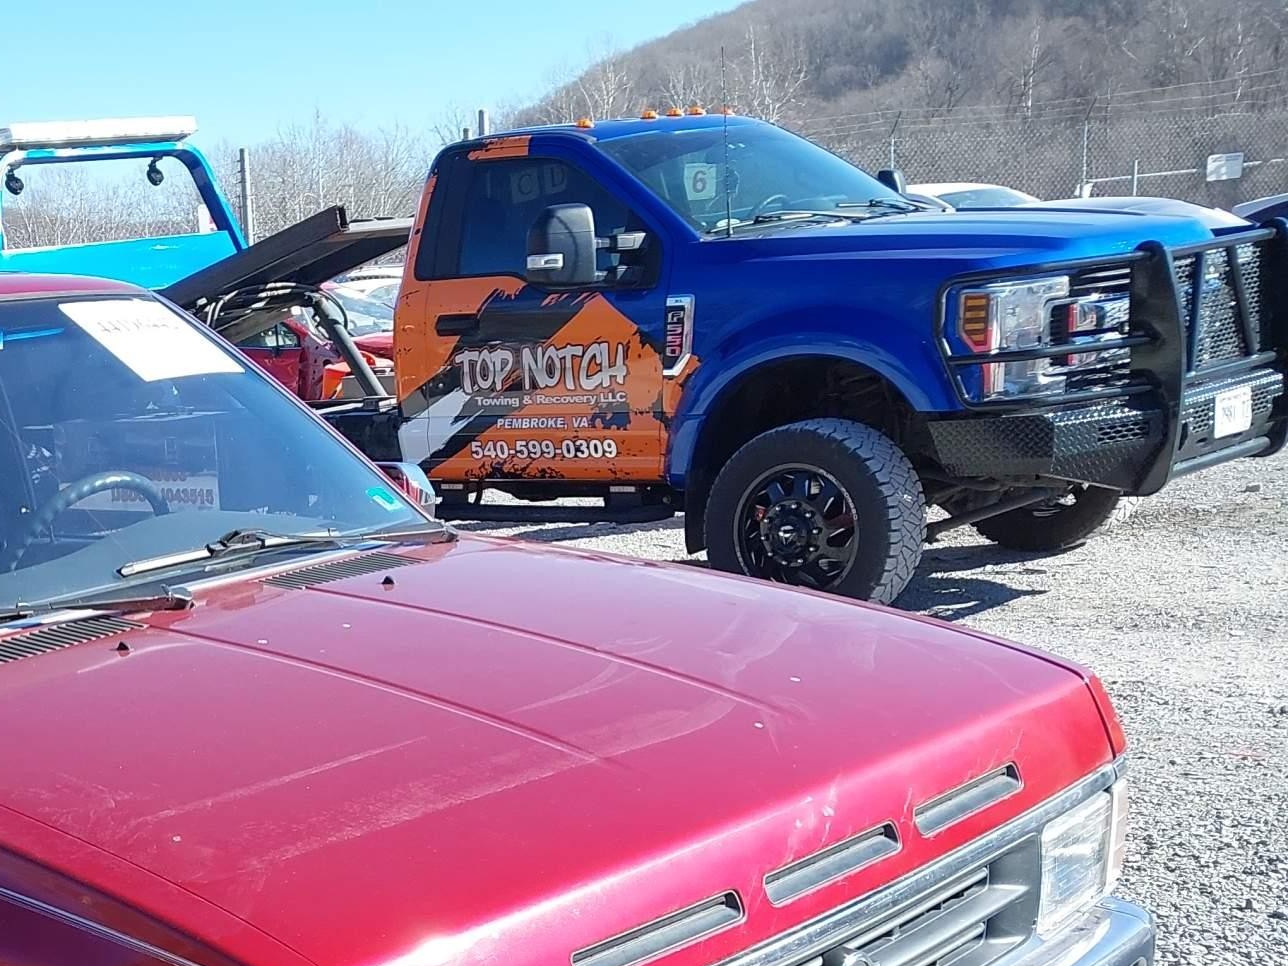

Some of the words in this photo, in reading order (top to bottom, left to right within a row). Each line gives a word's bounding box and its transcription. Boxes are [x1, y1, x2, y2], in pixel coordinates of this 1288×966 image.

[692, 170, 707, 193] 6
[455, 348, 513, 393] TOP
[522, 342, 627, 391] NOTCH
[475, 396, 519, 407] Towing
[523, 395, 532, 405] &
[537, 394, 597, 405] Recovery
[601, 391, 626, 402] LLC
[497, 418, 568, 429] PEMBROKE,
[471, 440, 617, 458] 540-599-0309
